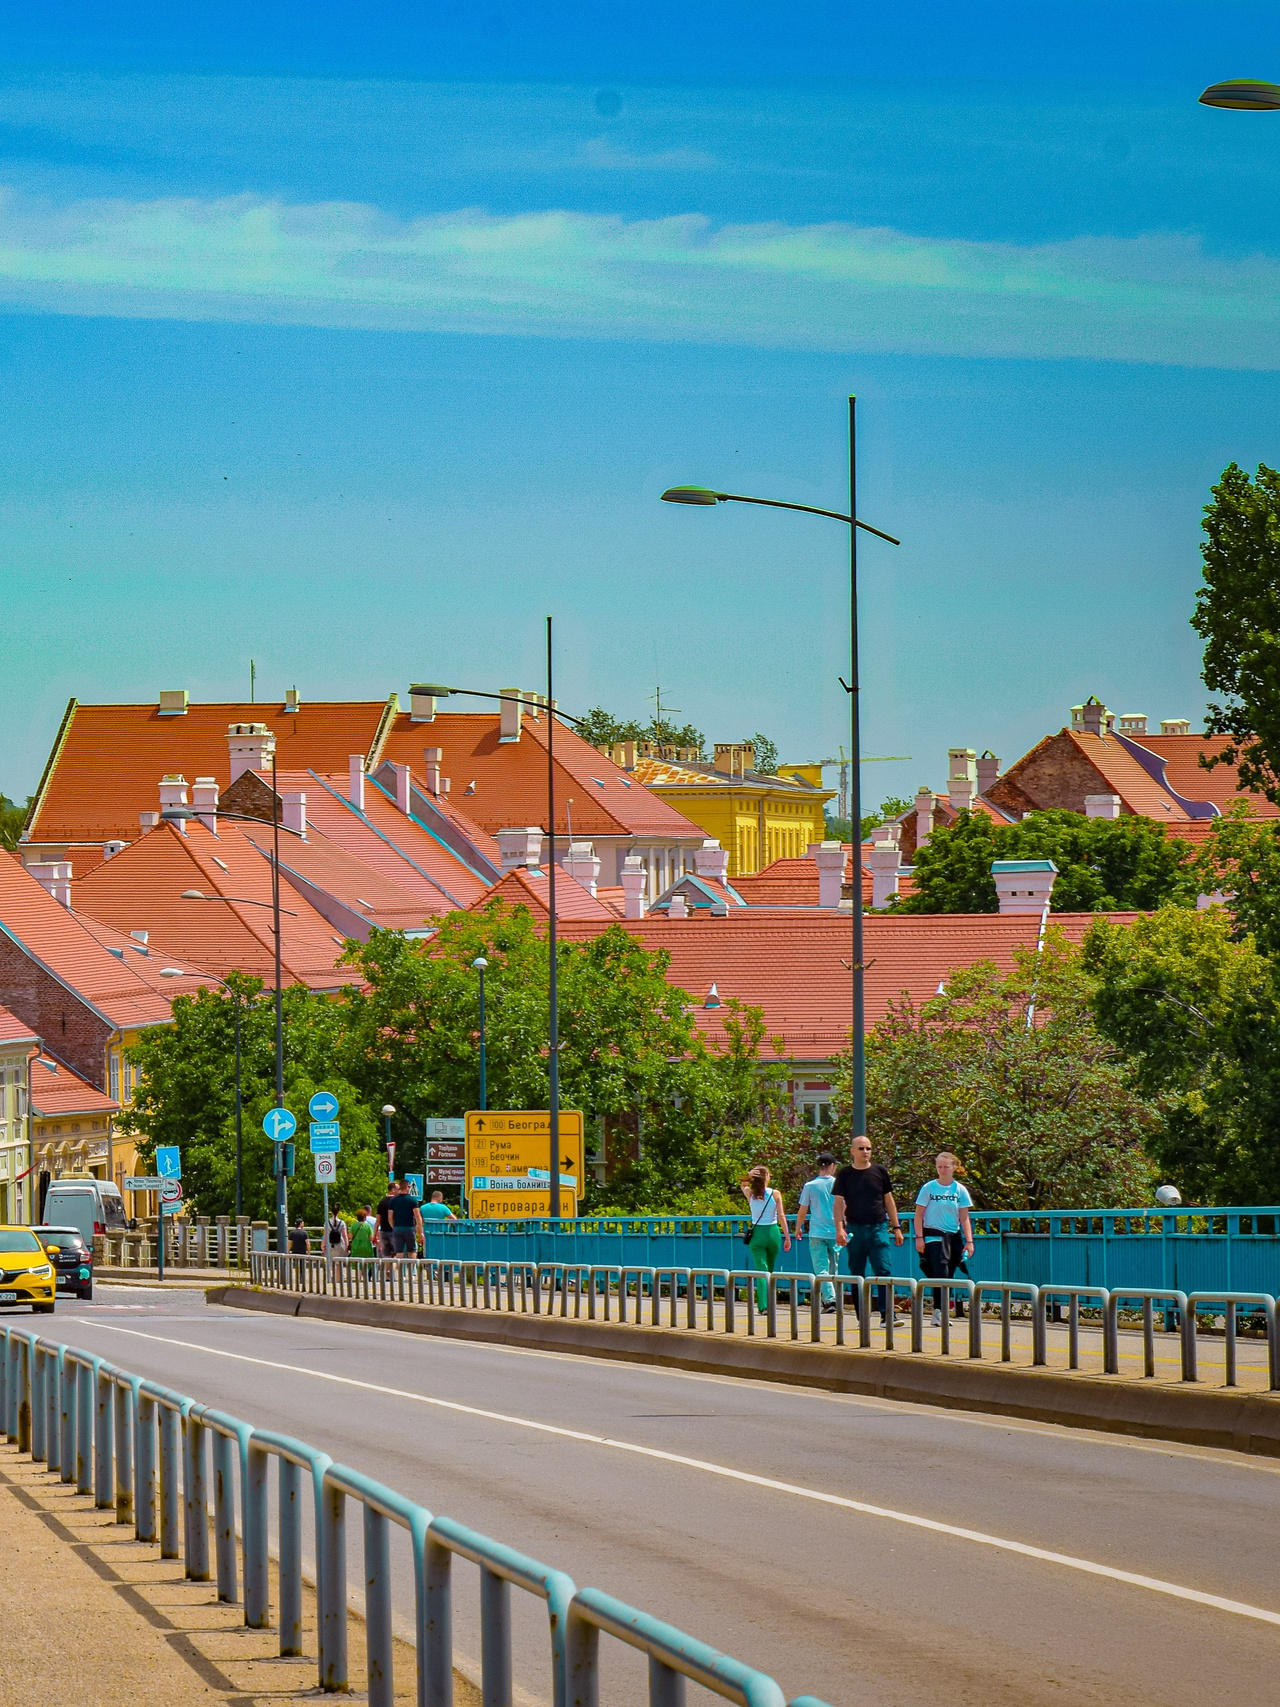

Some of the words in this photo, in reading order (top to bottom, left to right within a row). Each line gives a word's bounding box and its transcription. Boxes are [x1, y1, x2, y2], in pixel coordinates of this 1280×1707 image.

[476, 1140, 484, 1148] 21
[489, 1140, 512, 1151] Рума
[489, 1152, 520, 1161] Беочин
[474, 1158, 485, 1166] 119
[490, 1163, 503, 1175] Ср.
